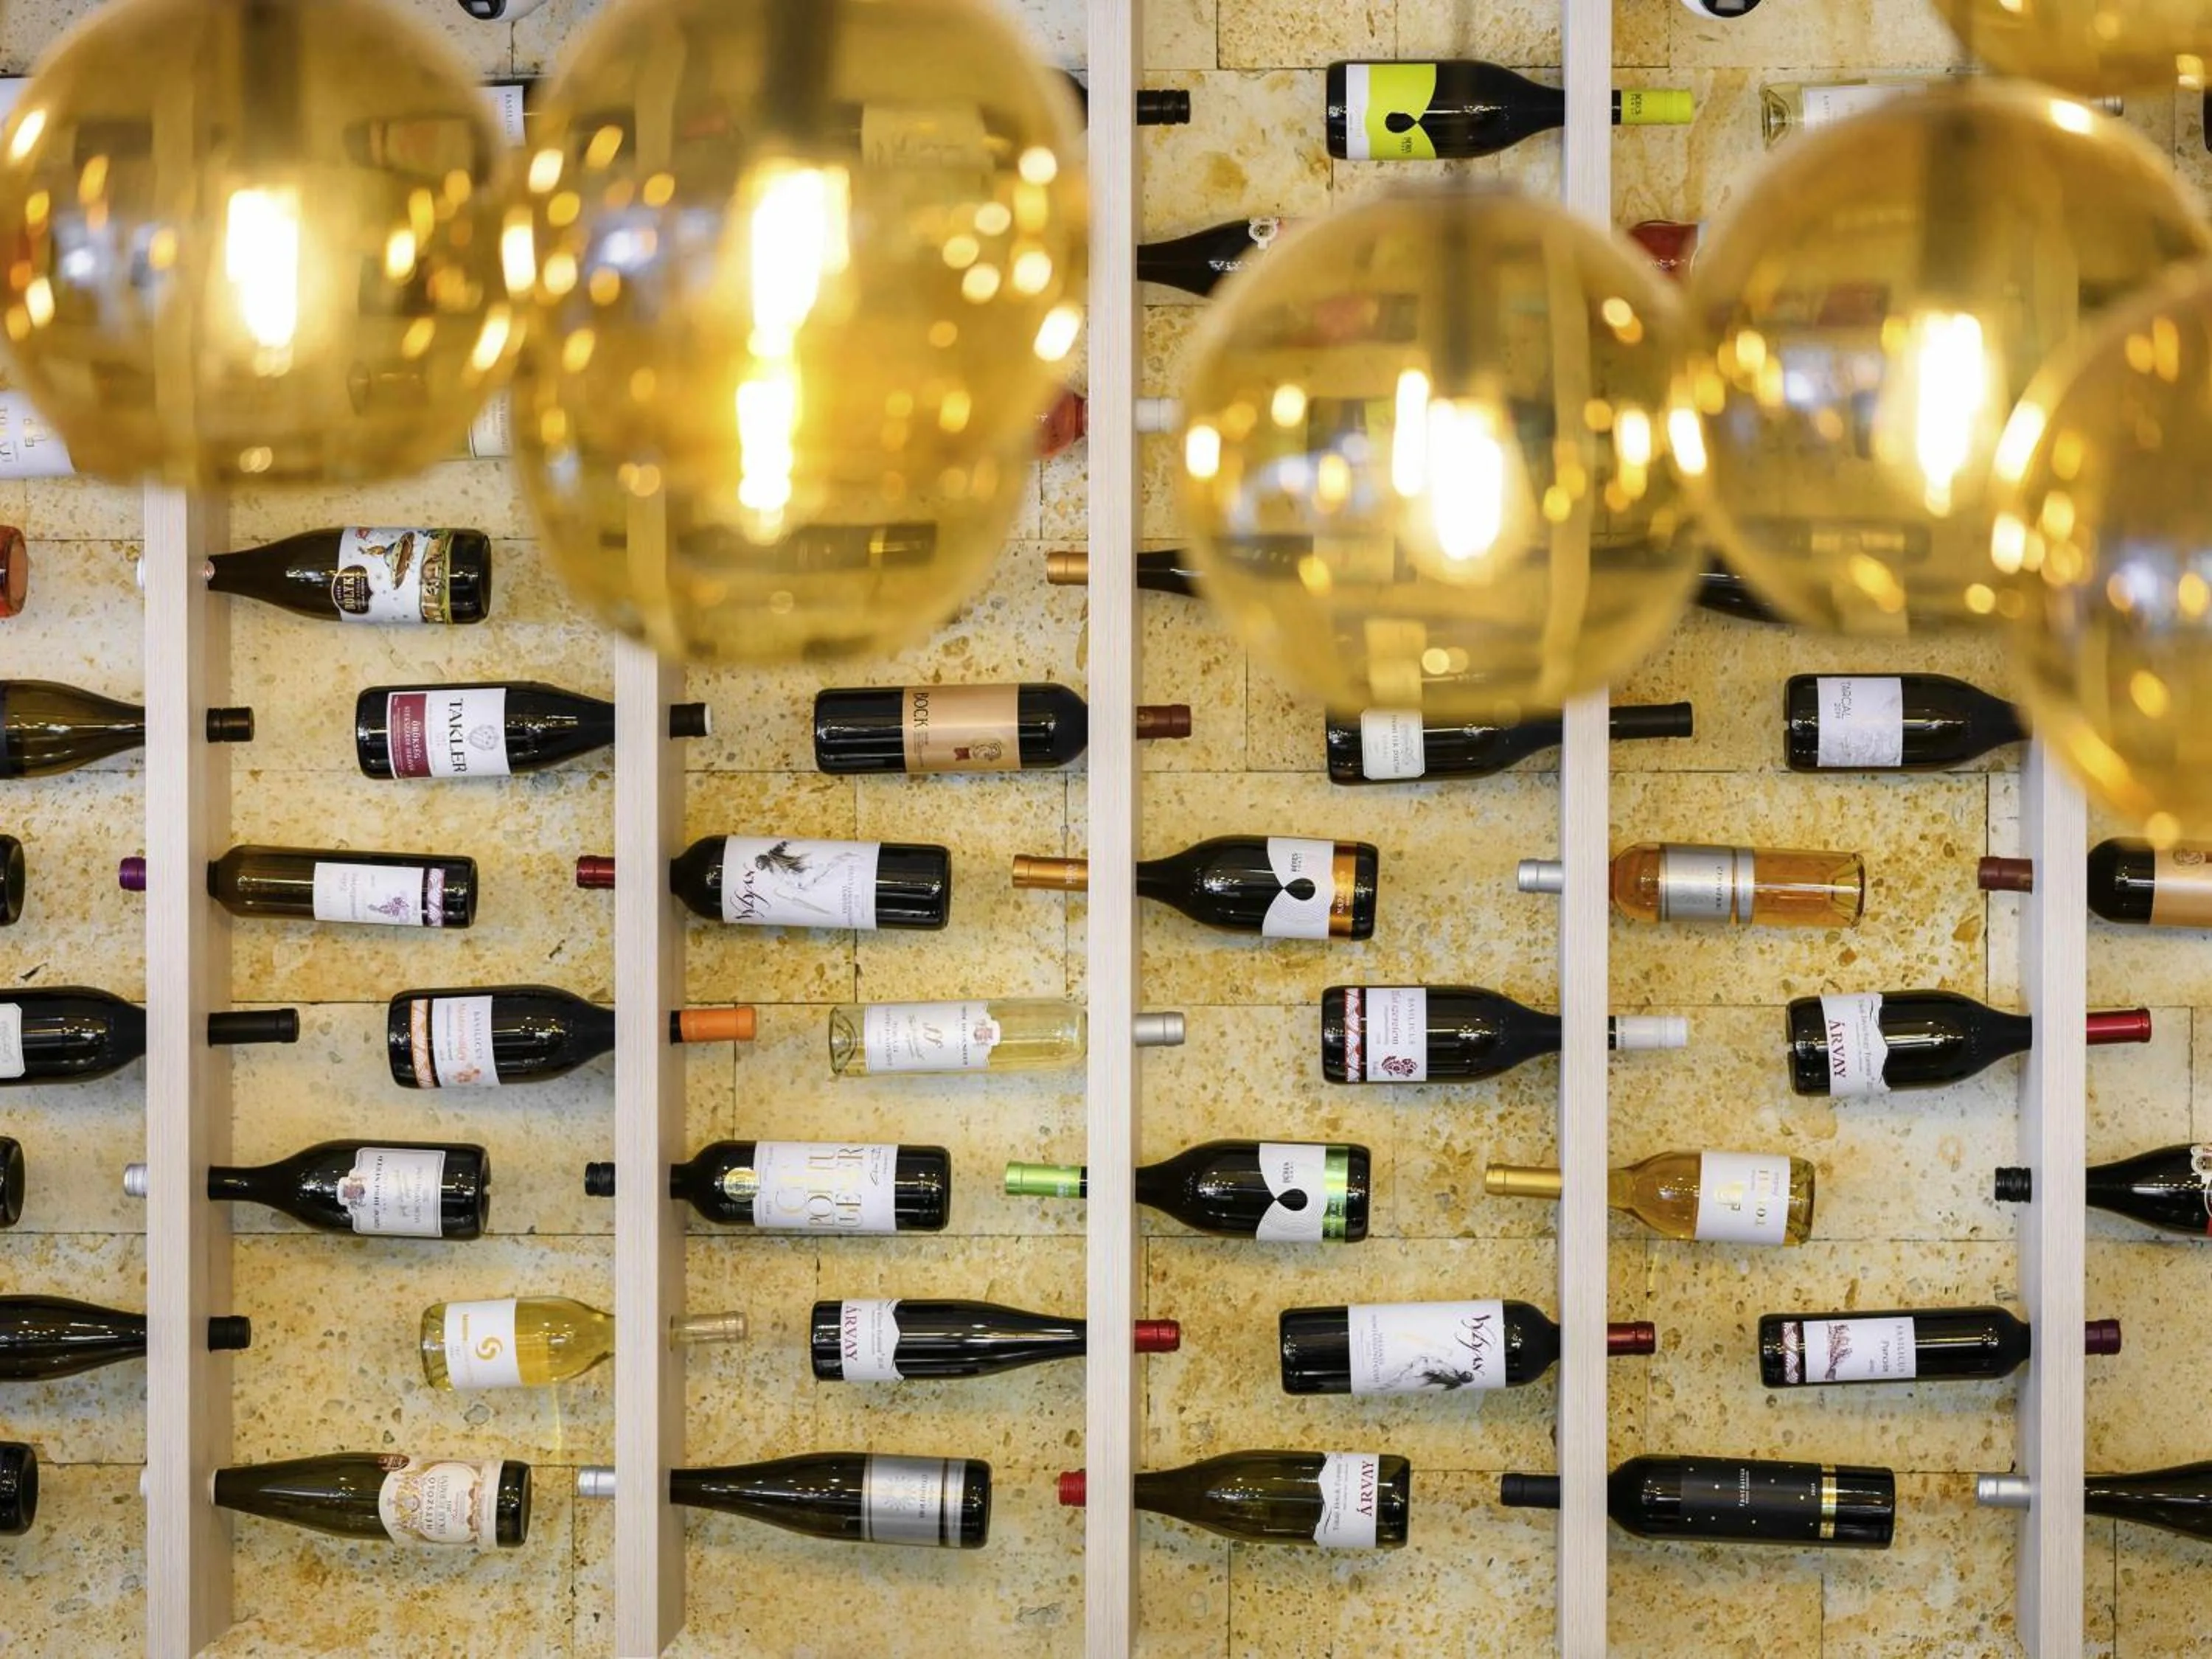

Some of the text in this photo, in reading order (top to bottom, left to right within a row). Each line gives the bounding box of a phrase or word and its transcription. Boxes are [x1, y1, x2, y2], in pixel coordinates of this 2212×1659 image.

[448, 698, 469, 773] TAKLER
[913, 692, 931, 729] BOCK
[1827, 1018, 1847, 1079] ÁRVAY
[844, 1304, 863, 1361] ÁRVAY
[1357, 1460, 1374, 1517] ÁRVAY
